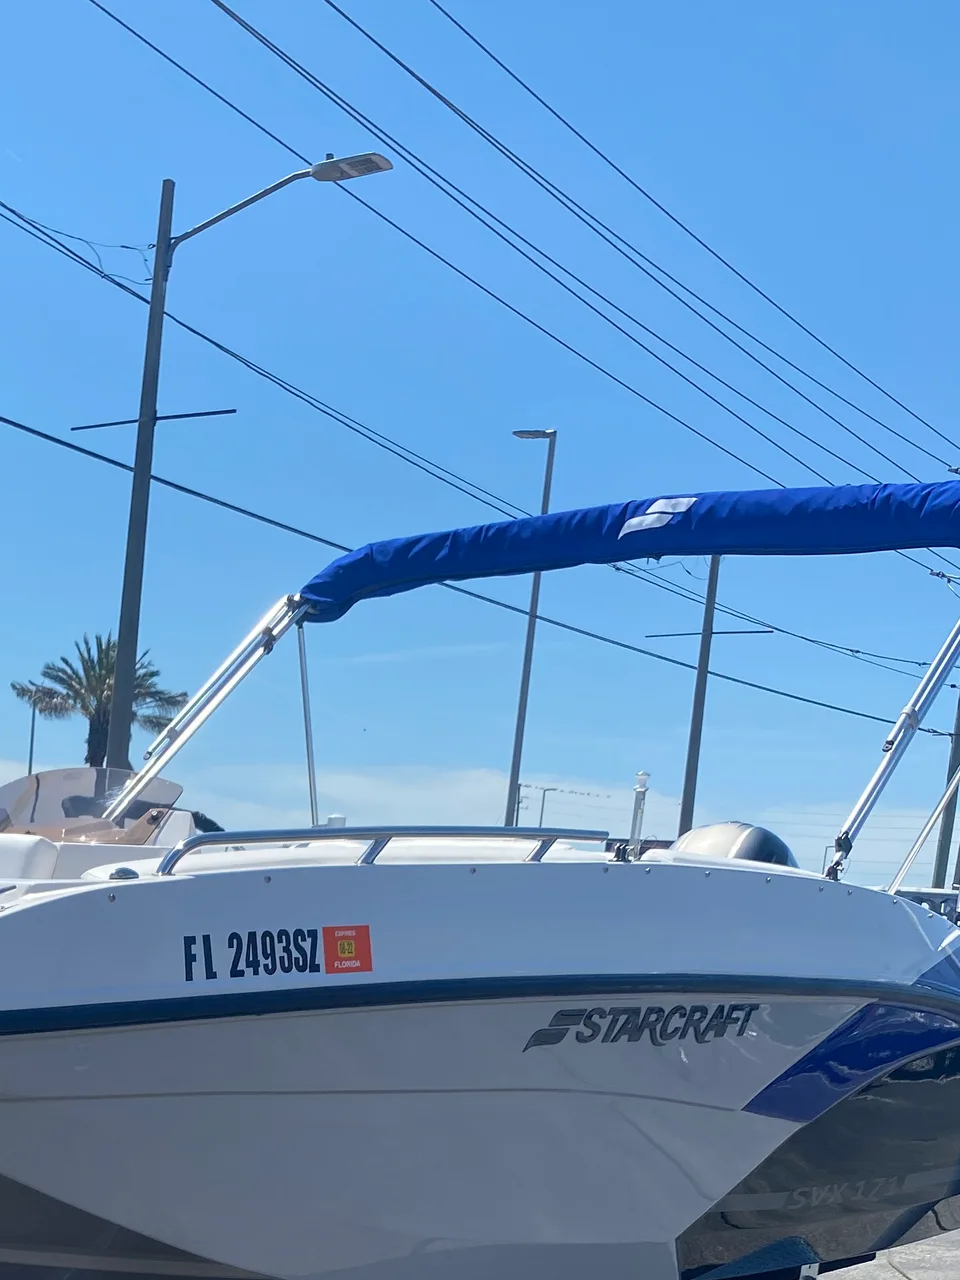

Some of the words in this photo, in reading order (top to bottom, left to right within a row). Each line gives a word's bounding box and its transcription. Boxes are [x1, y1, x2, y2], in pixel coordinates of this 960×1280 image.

[183, 934, 218, 982] FL
[227, 928, 321, 979] 2493SZ
[334, 960, 361, 969] FLORIDA
[575, 1003, 760, 1047] STARCRAFT
